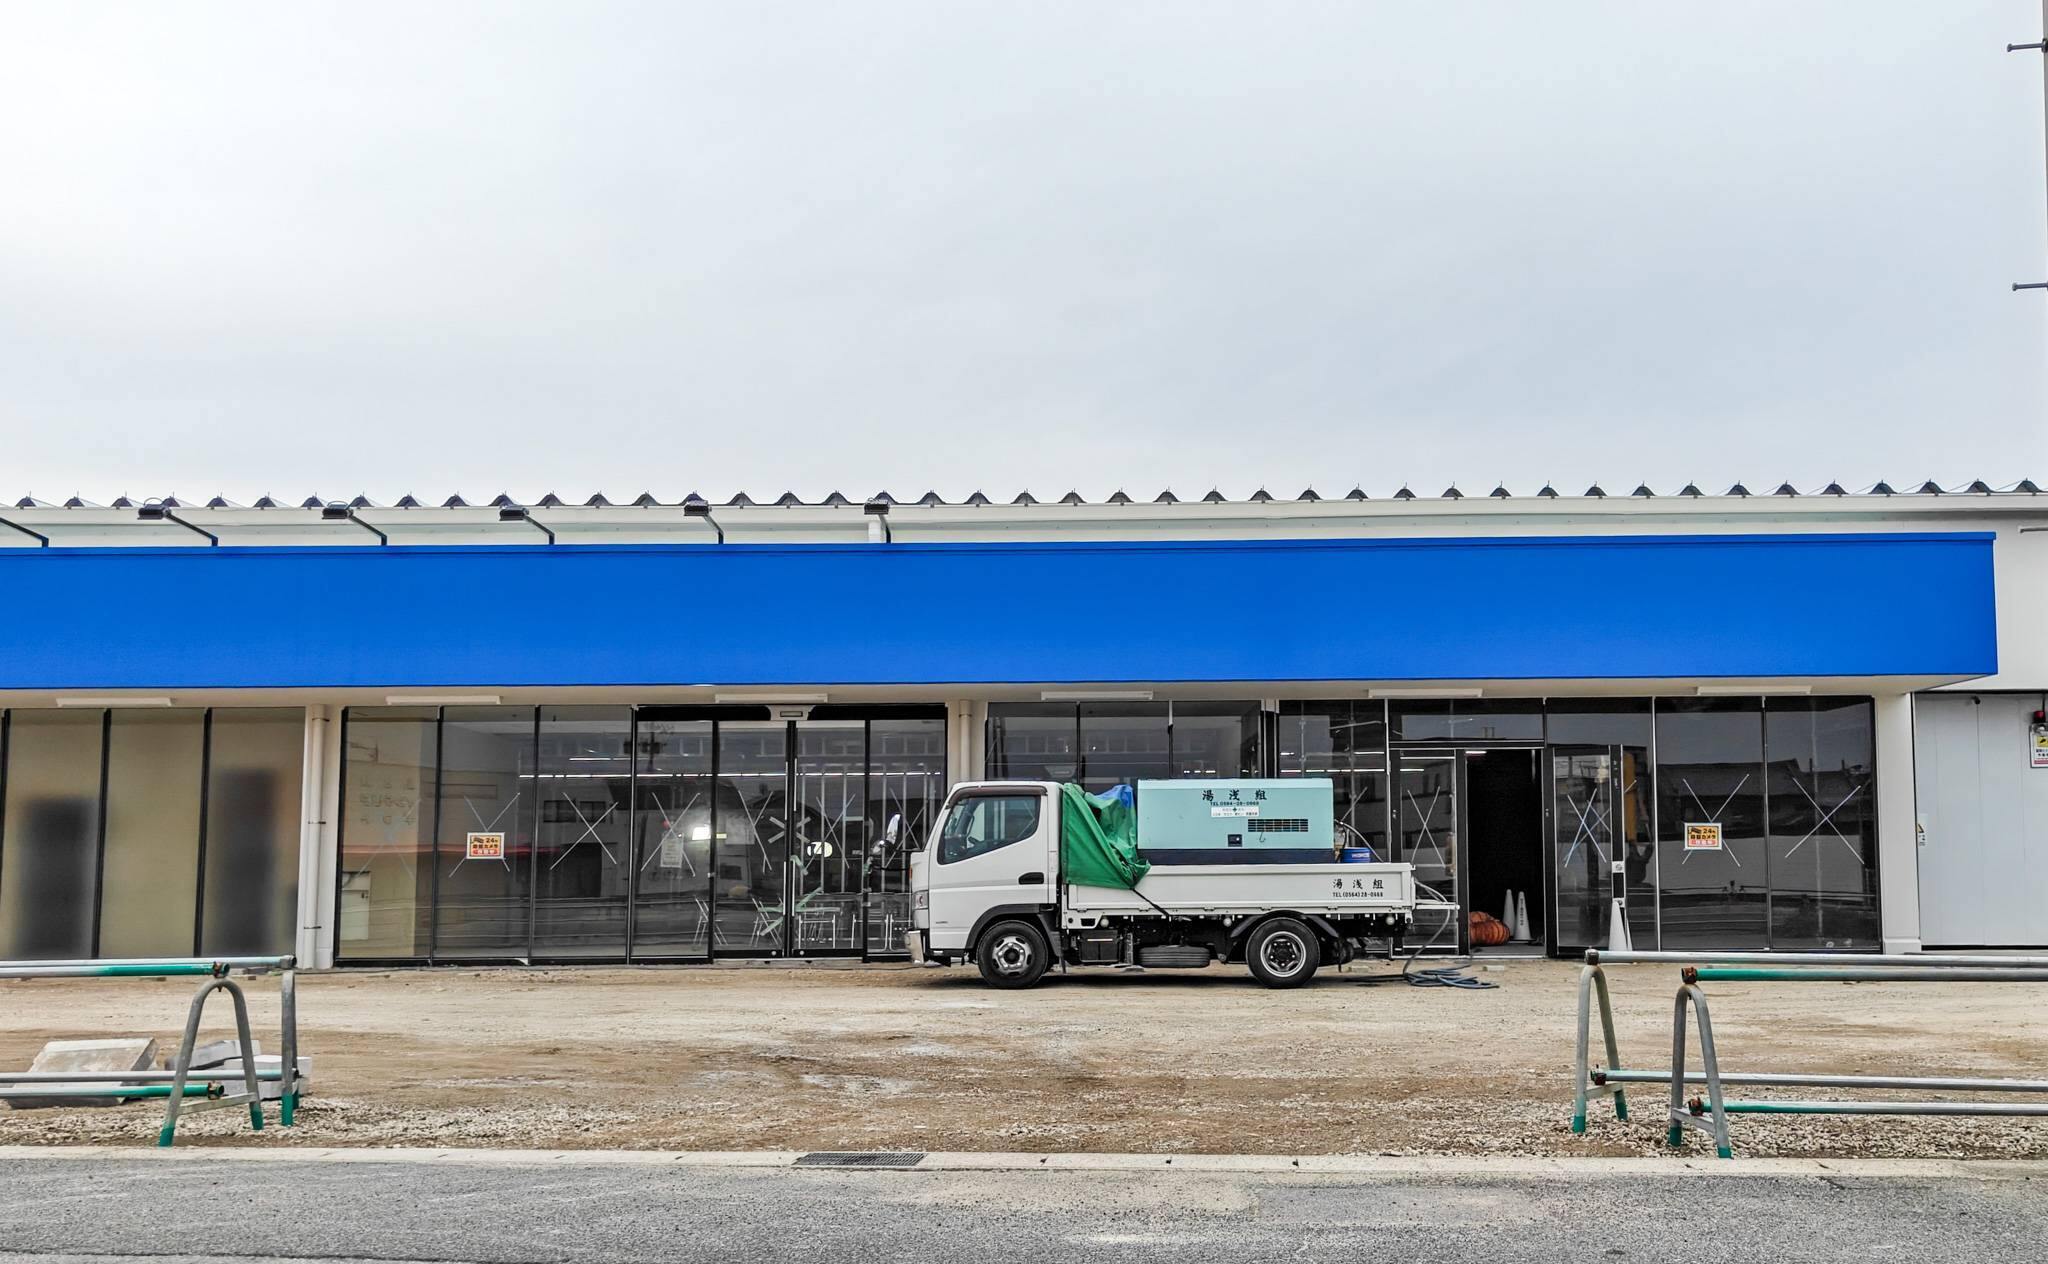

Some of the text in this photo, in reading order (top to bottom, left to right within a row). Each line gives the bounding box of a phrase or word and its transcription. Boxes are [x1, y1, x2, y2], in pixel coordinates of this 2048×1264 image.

[1202, 789, 1268, 802] 湯浅組
[1332, 878, 1384, 889] 湯浅組
